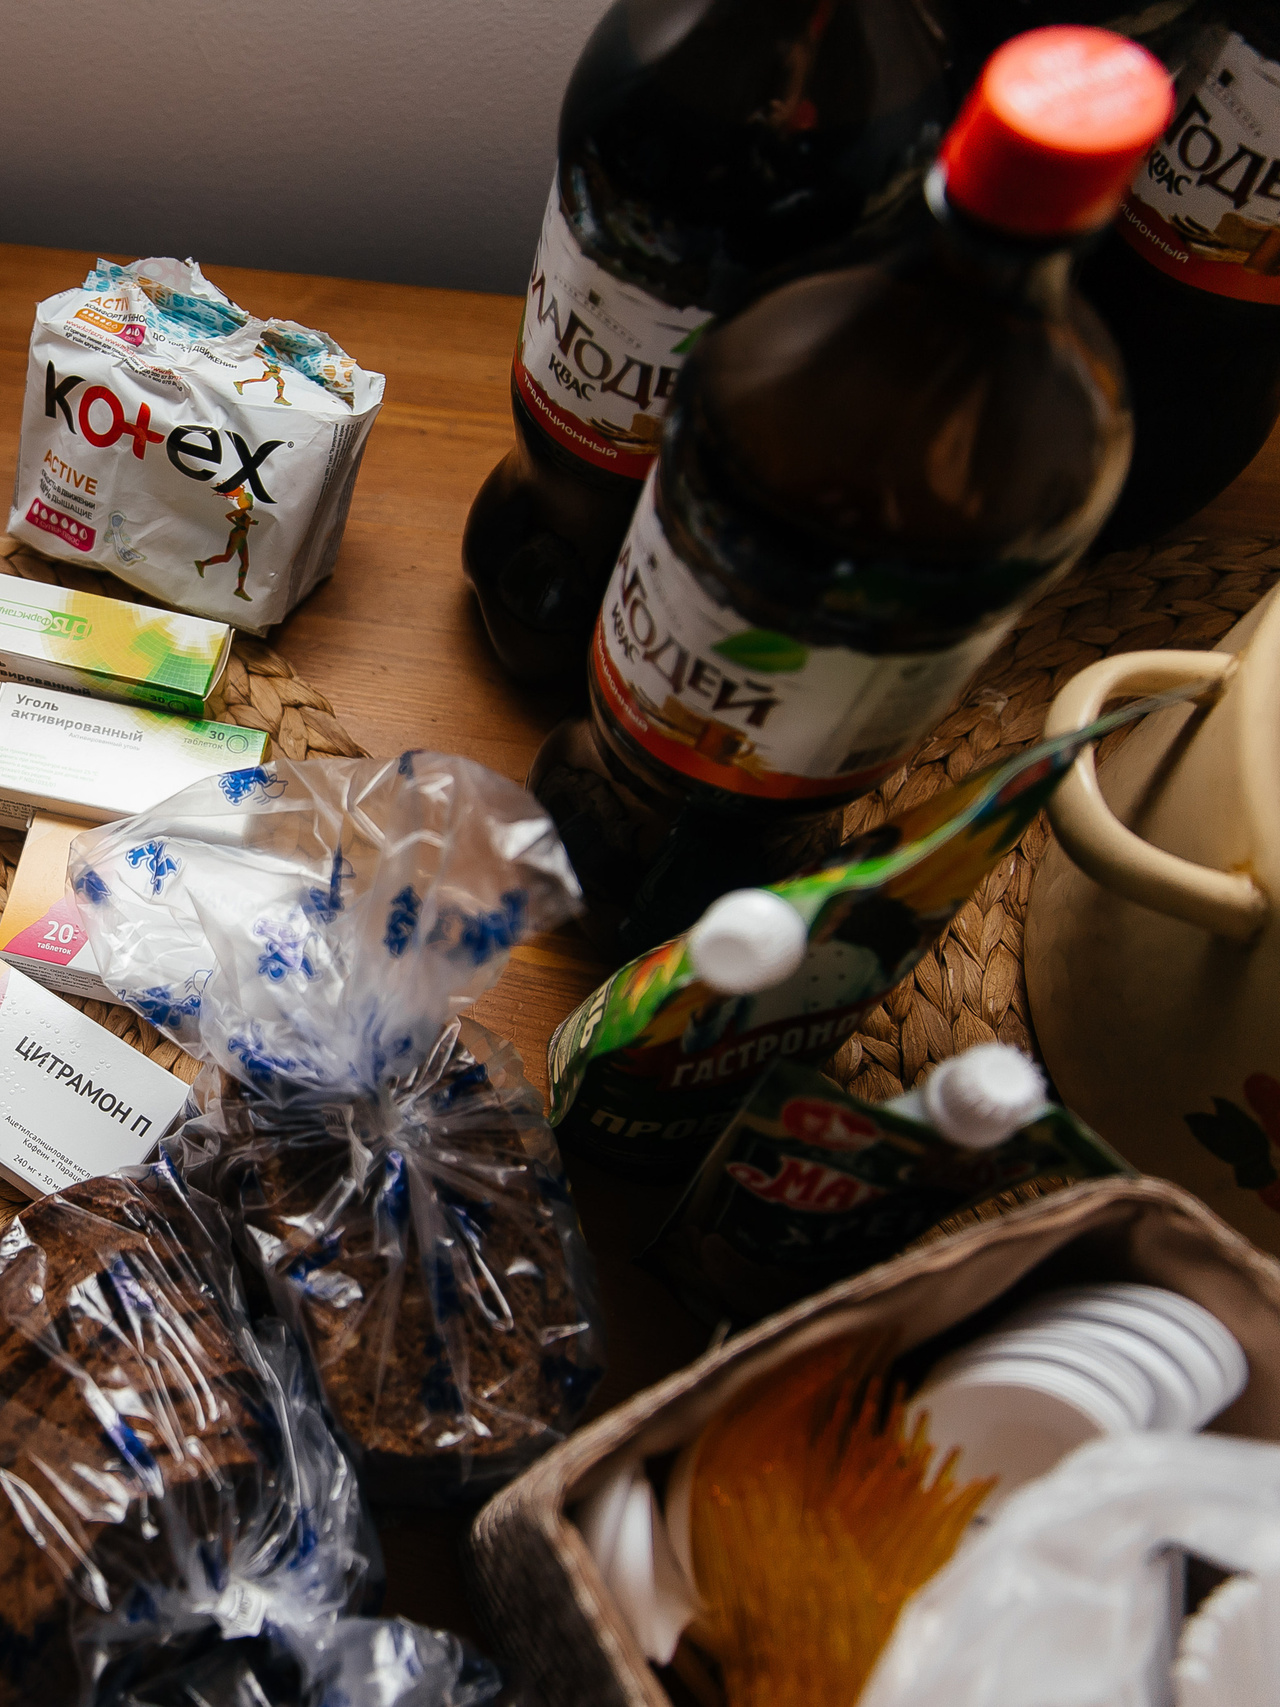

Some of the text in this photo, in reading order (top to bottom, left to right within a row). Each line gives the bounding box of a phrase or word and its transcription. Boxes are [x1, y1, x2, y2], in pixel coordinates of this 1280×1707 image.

[1164, 93, 1280, 209] ГОДЕ
[1119, 203, 1190, 264] ИЦИОННЫЙ
[192, 344, 237, 369] ДВИЖЕНИИ
[548, 352, 596, 402] КВАС
[522, 370, 619, 460] ТРАДИЦИОННЫЙ
[43, 448, 100, 495] ACTIVE
[50, 494, 93, 519] ДЫШАЩИЕ
[620, 549, 779, 728] АГОДЕЙ
[15, 693, 60, 712] Уголь
[10, 708, 143, 743] активированный
[67, 731, 139, 751] Активированный уголь
[208, 730, 224, 741] 30
[183, 736, 223, 751] таблеток
[37, 941, 72, 955] таблеток
[43, 920, 74, 944] 20
[13, 1034, 132, 1126] ЦИТРАМОН
[129, 1114, 152, 1138] П
[4, 1115, 74, 1166] Ацетилсалициловая
[12, 1153, 53, 1186] 240 мг 30
[22, 1137, 82, 1184] Кофеин Параце
